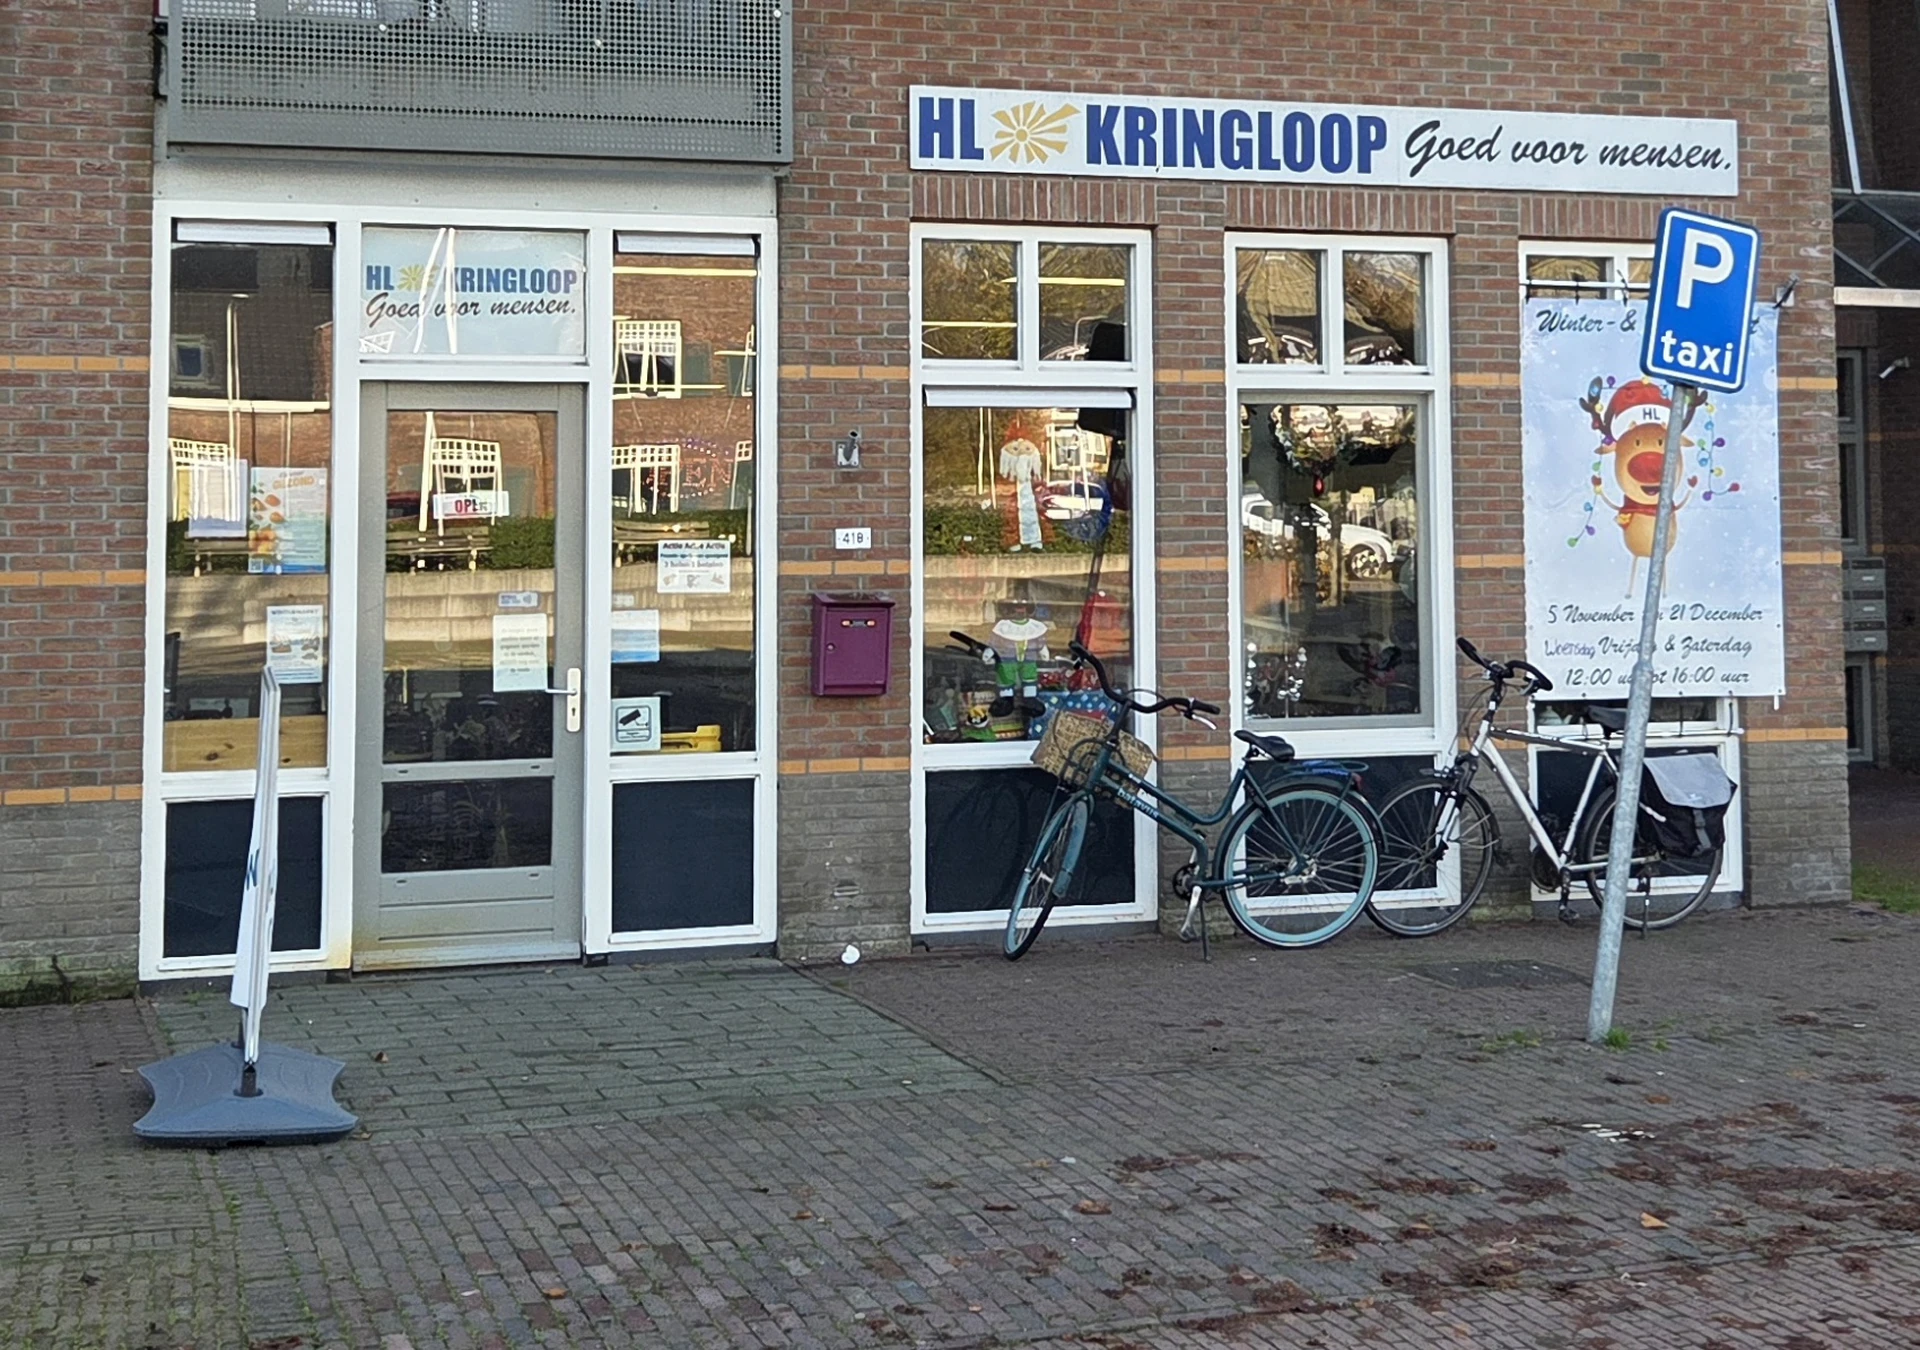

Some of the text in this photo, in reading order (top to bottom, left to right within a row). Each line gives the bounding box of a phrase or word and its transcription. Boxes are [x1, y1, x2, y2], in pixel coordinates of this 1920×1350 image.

[919, 96, 1732, 178] HL KRINGLOOP Goed voor mensen.
[366, 265, 395, 291] HL
[1676, 227, 1735, 309] P
[490, 296, 576, 316] mensen.
[1620, 309, 1637, 332] &
[1660, 329, 1734, 376] taxi
[1642, 407, 1661, 420] HL
[1547, 605, 1558, 624] 5
[1562, 604, 1635, 624] November
[1669, 603, 1685, 621] 21
[1689, 603, 1763, 622] December
[1664, 634, 1676, 652] &
[1680, 635, 1753, 660] Zaterdag
[1565, 667, 1613, 685] 12:00
[1672, 666, 1716, 684] 16:00
[1720, 671, 1750, 684] uur
